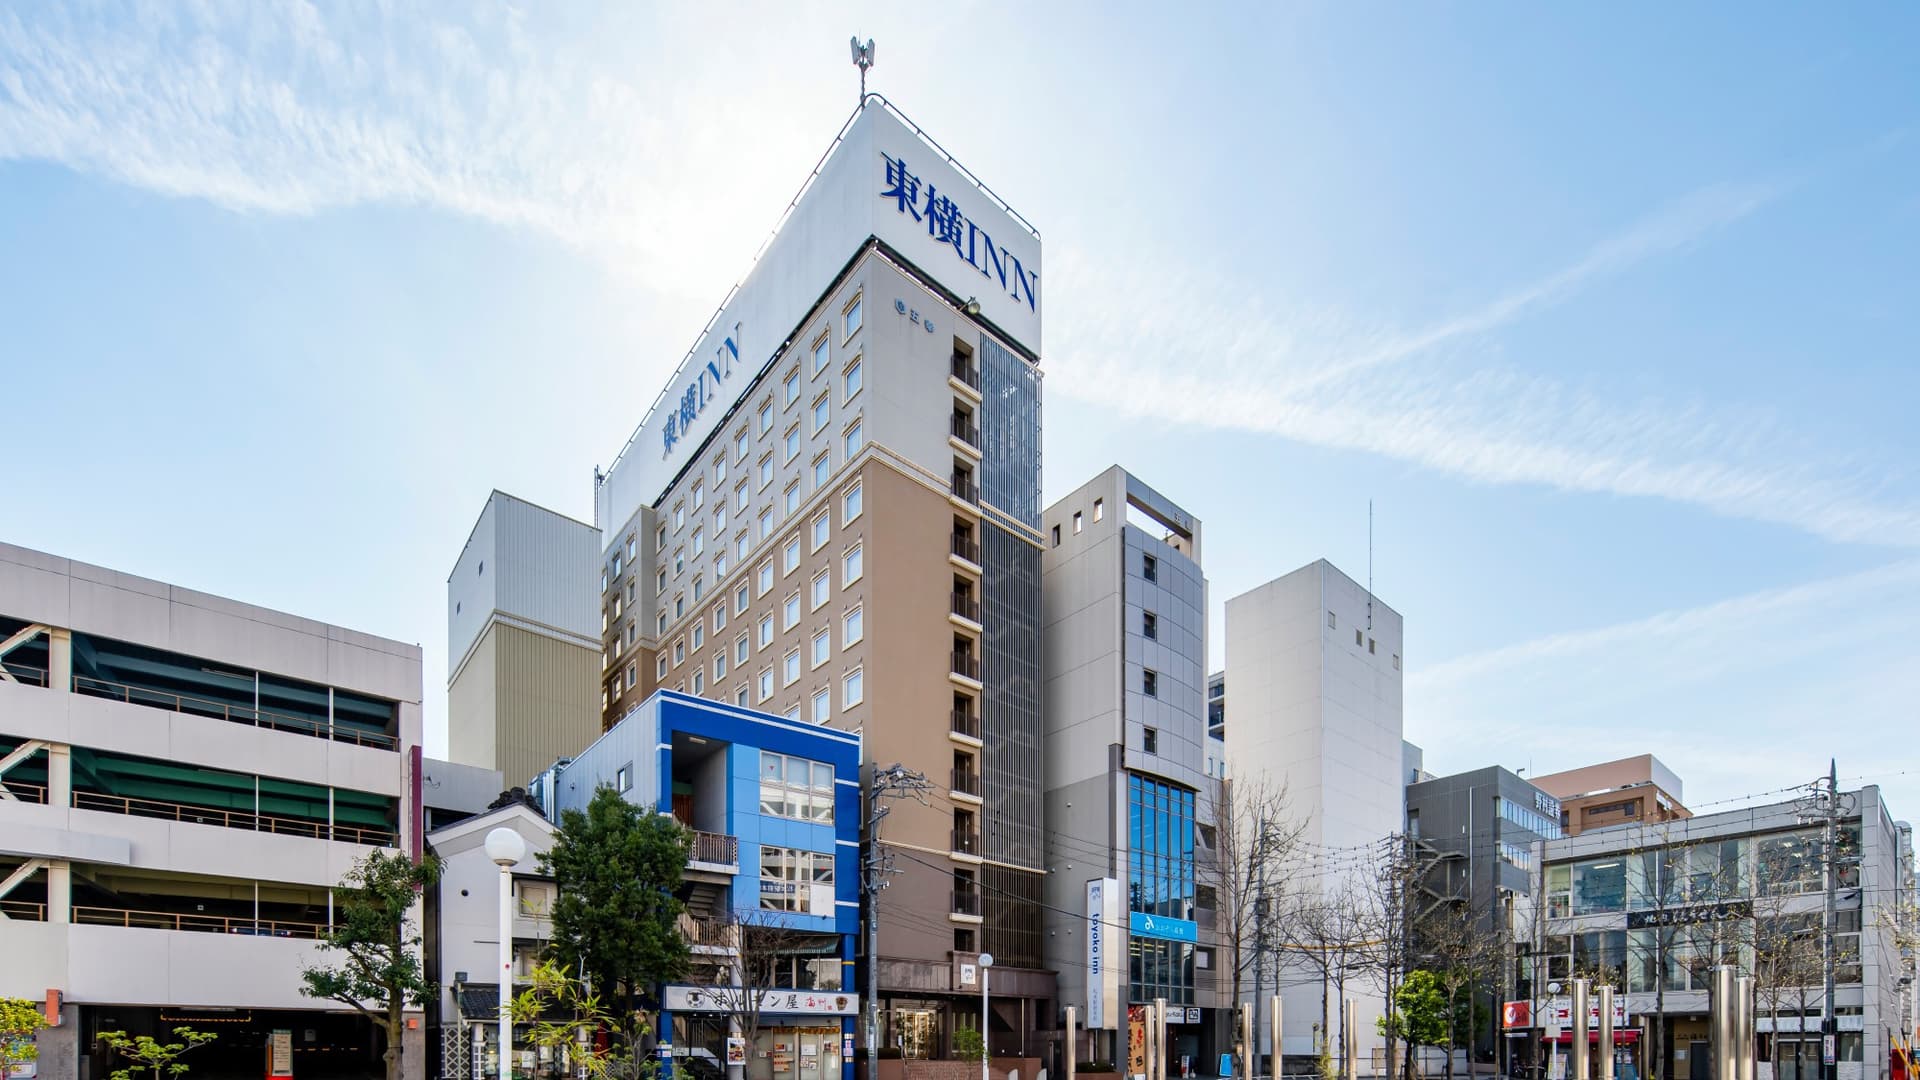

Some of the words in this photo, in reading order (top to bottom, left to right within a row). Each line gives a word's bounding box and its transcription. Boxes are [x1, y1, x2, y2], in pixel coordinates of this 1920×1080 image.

[881, 152, 1039, 313] 東横INN
[662, 321, 743, 460] 東横INN
[1090, 913, 1101, 954] toyoko
[1092, 956, 1101, 975] inn
